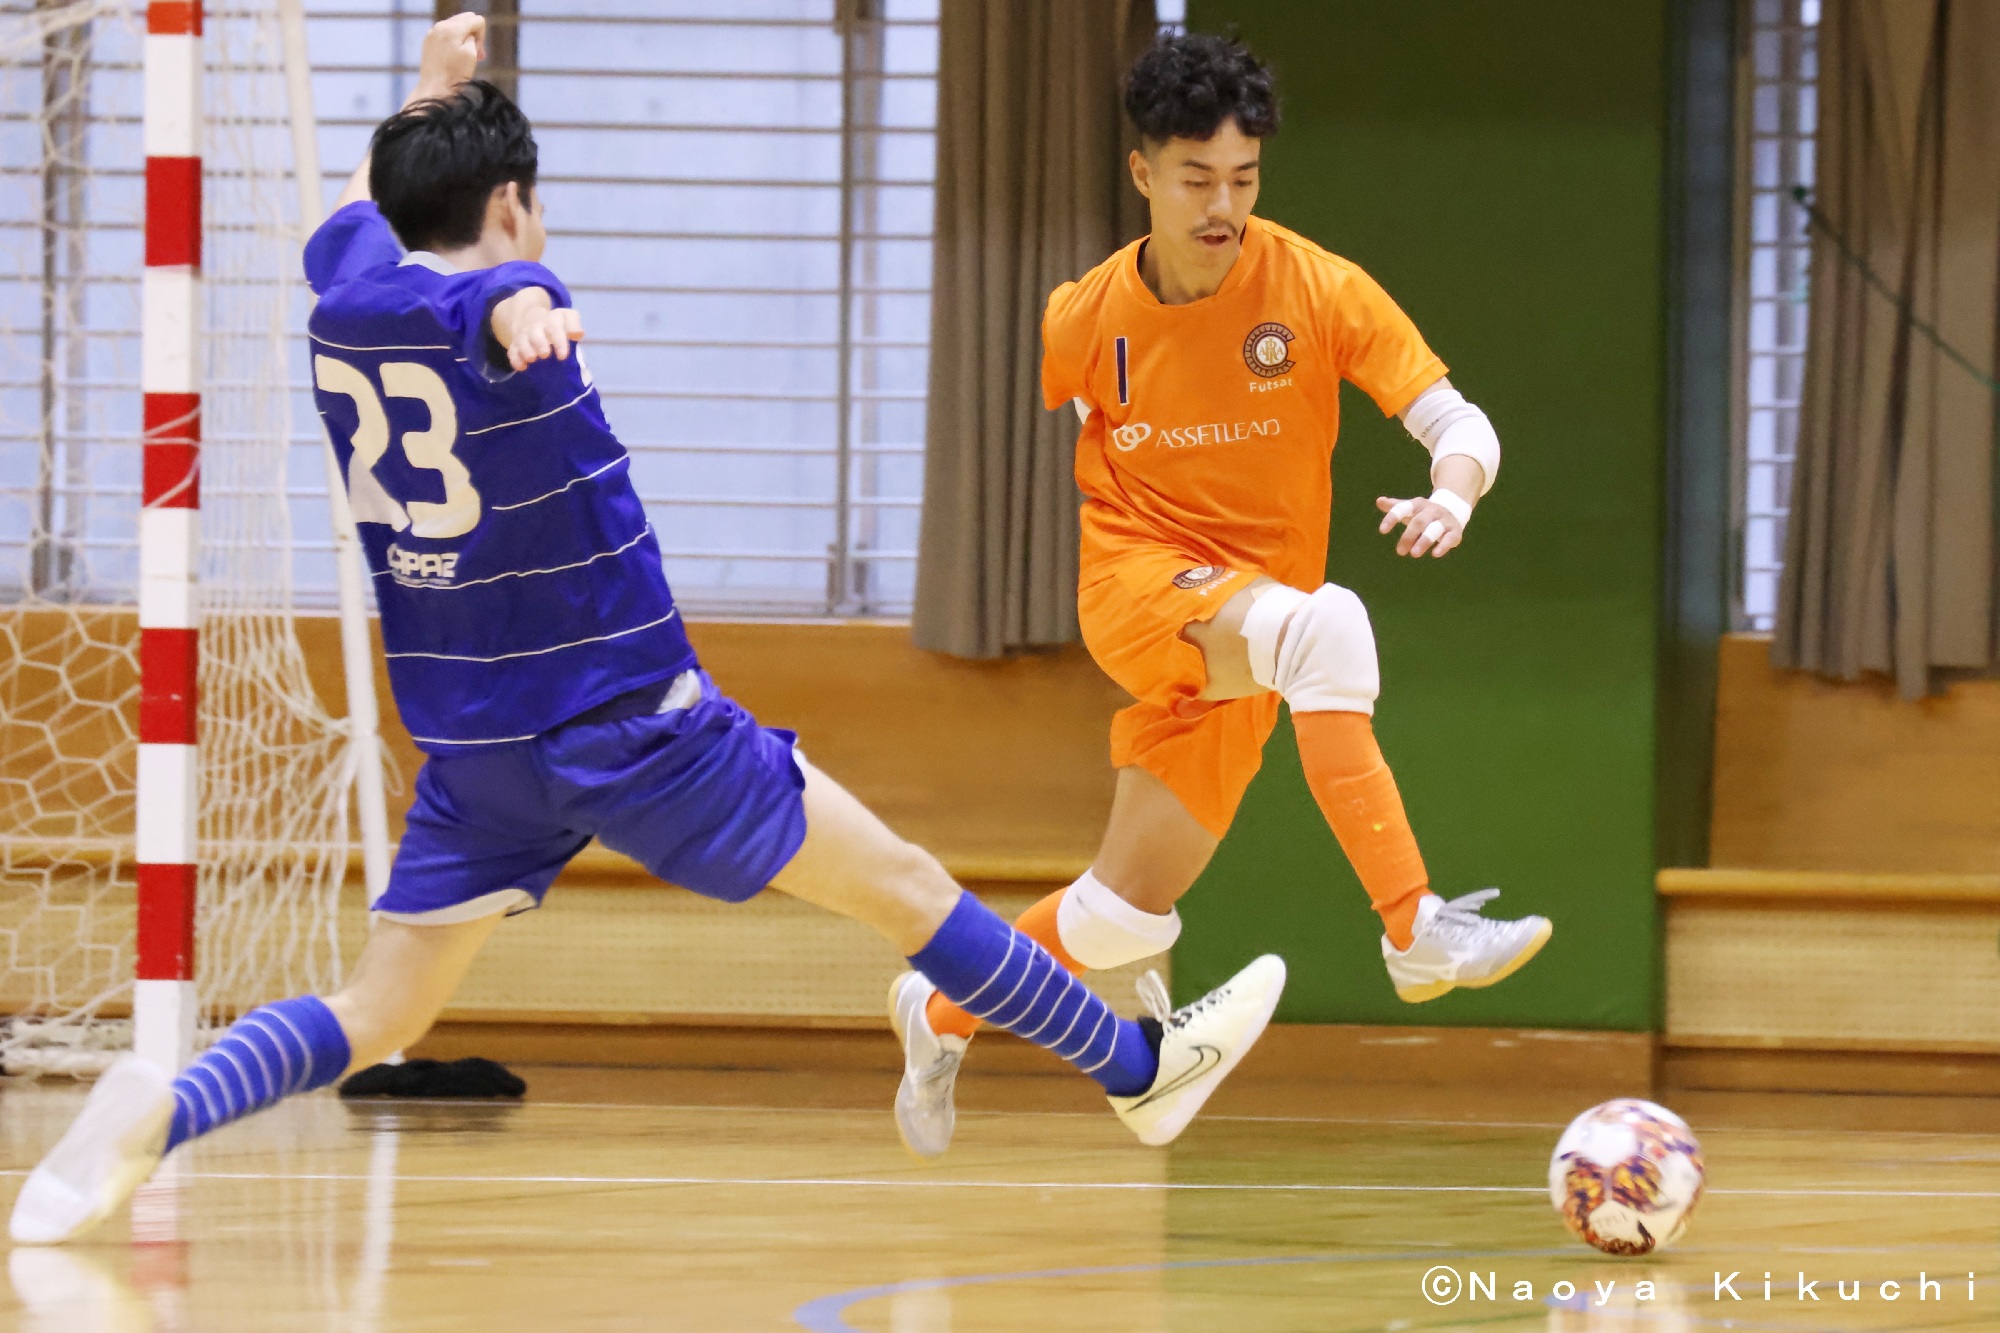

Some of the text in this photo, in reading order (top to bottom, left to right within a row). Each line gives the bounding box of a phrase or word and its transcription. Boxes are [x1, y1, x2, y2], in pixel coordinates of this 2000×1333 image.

[1249, 378, 1293, 393] Futsal
[315, 354, 481, 538] 23
[1156, 418, 1280, 448] ASSETLEAD
